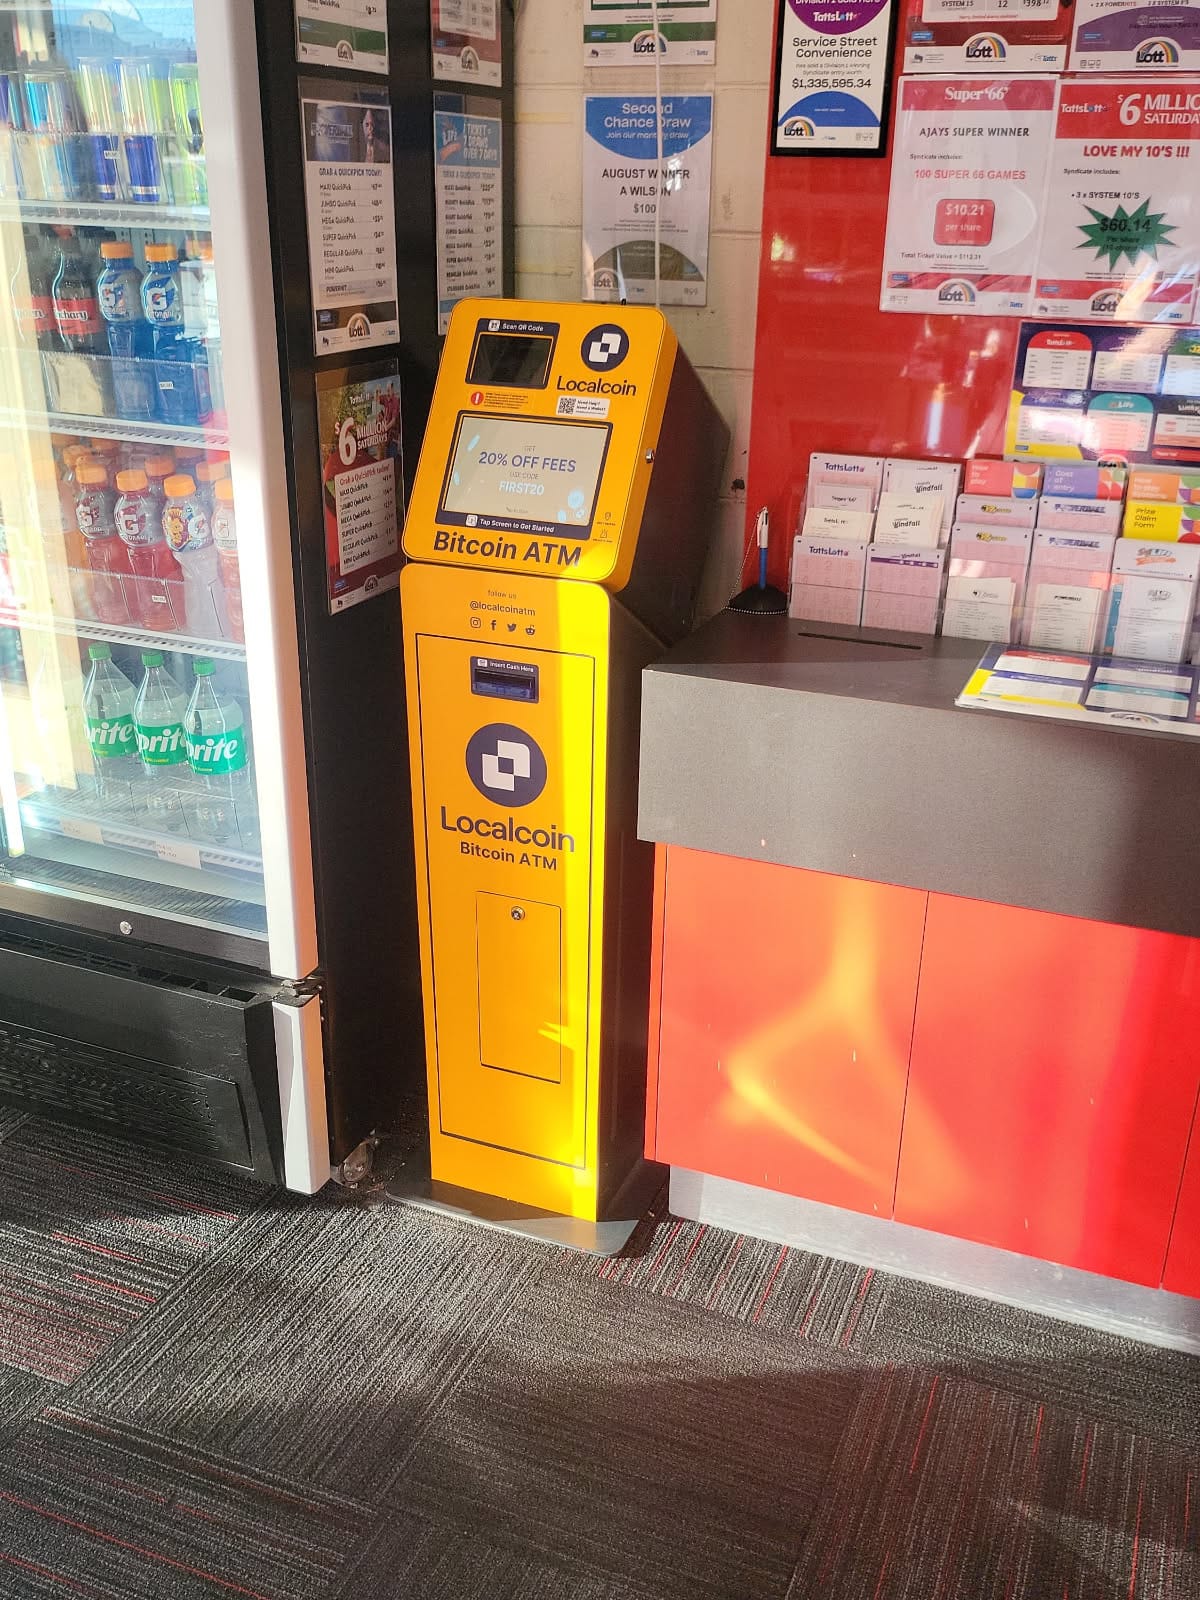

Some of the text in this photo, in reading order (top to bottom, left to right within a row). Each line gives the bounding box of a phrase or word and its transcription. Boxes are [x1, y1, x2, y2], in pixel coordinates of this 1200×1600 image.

[793, 36, 878, 47] Service Street
[796, 47, 872, 58] Convenience
[792, 78, 872, 89] $1,335,595.34
[944, 86, 980, 103] Super
[604, 117, 654, 128] Chance
[1144, 113, 1200, 125] SATURDA
[920, 127, 1030, 138] AJAYS SUPER WINNER
[1083, 146, 1117, 157] LOVE
[1120, 146, 1142, 157] MY
[602, 168, 646, 179] AUGUST
[915, 170, 931, 178] 100
[934, 170, 969, 178] SUPER
[987, 170, 1026, 180] GAMES
[1064, 168, 1092, 176] Syndicate
[620, 186, 627, 195] A
[945, 203, 985, 217] $10.21
[945, 224, 958, 232] per
[1099, 218, 1152, 233] $60.14
[502, 322, 544, 332] Scan QR Code
[557, 375, 637, 397] Localcoin
[478, 451, 577, 473] 20% OFF FEES
[825, 462, 865, 473] TattsLotto
[499, 480, 545, 496] FIRST20
[915, 483, 943, 494] Windfall
[479, 518, 491, 527] Tap
[491, 519, 512, 529] Screen
[520, 523, 531, 531] Get
[532, 524, 554, 533] Started
[892, 520, 921, 532] Windfall
[434, 530, 582, 567] Bitcoin ATM
[809, 546, 849, 557] TattsLotto
[487, 589, 507, 598] follow
[469, 600, 536, 617] @localcoinatm
[489, 660, 534, 673] Insert Cash Here
[441, 805, 575, 853] Localcoin
[460, 841, 557, 871] Bitcoin ATM
